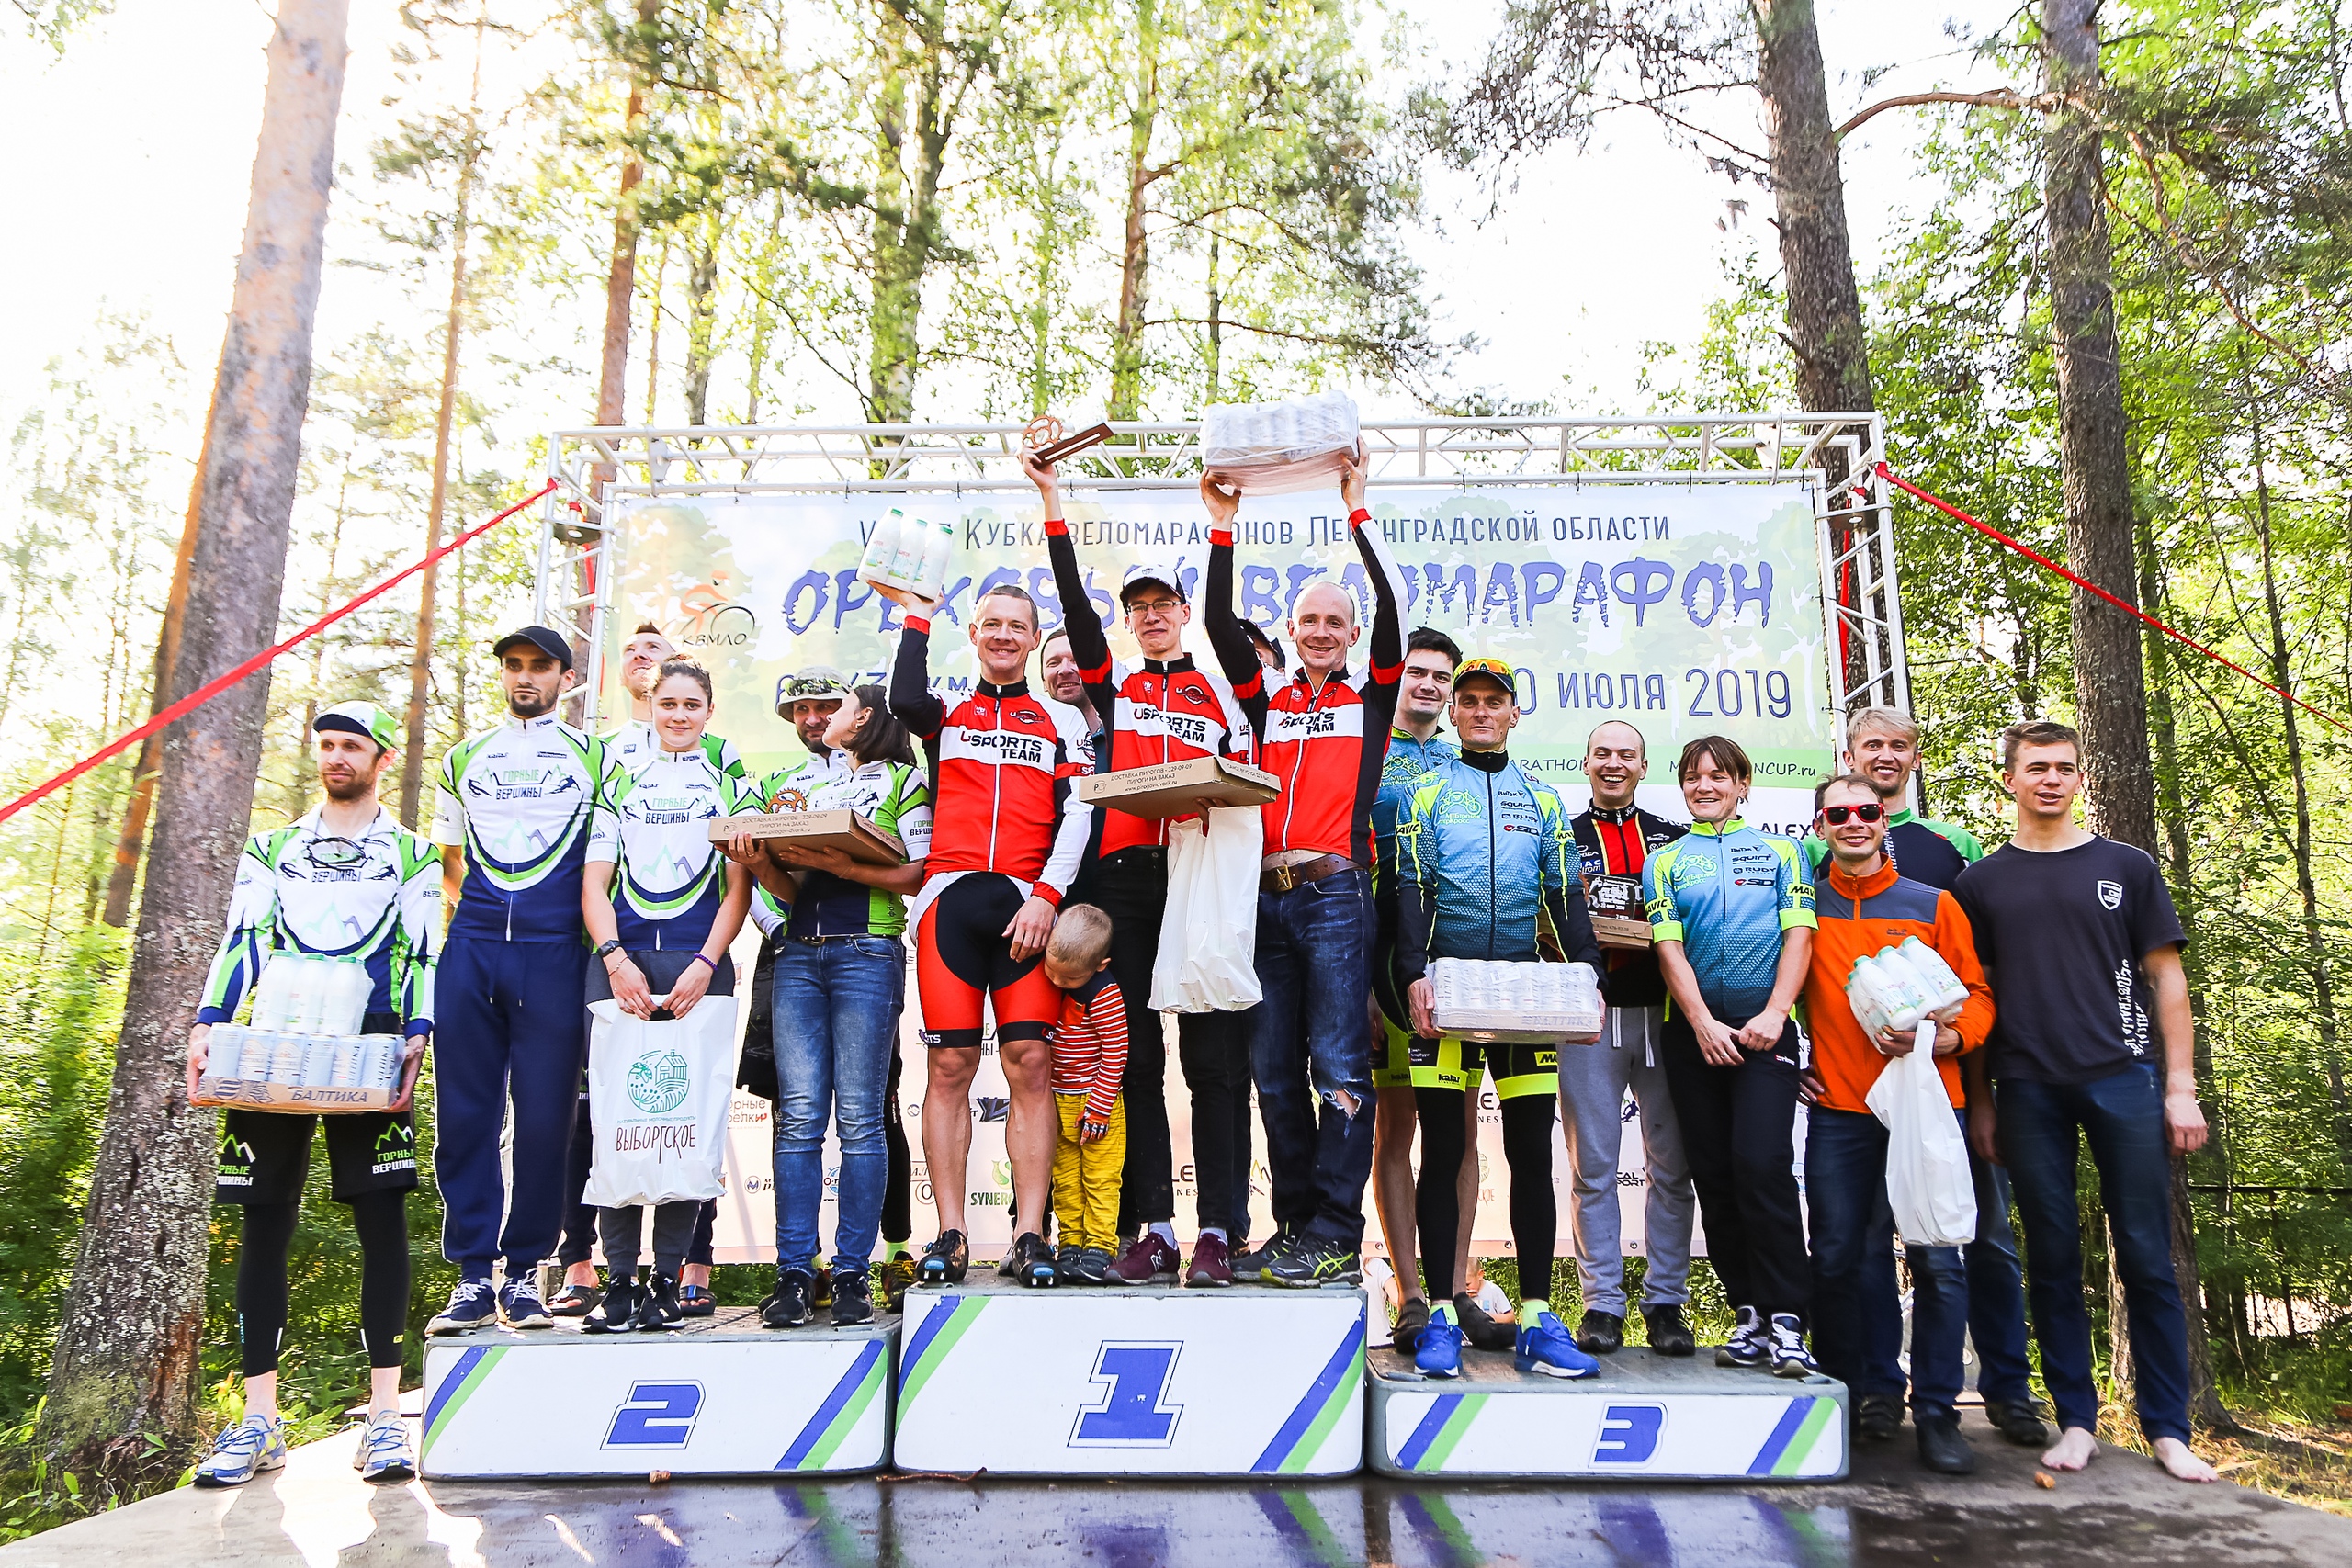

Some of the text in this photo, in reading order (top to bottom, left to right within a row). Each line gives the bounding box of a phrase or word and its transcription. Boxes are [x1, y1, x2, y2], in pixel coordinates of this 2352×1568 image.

[1071, 521, 1293, 545] ВЕЛОМАРАОНОВ
[1307, 510, 1539, 547] ЛЕНГРАДСКОЙ
[1553, 516, 1669, 541] ОБЛАСТИ
[1241, 557, 1773, 628] ВЛМАРАФОН
[1685, 669, 1791, 718] 2019
[1001, 748, 1041, 763] TEAM
[496, 787, 542, 799] ВЕРШИНЫ
[652, 797, 688, 808] ГОРНЫЕ
[645, 813, 689, 824] ВЕРШИНЫ
[311, 870, 361, 882] ВЕРШИНЫ
[1646, 899, 1668, 915] AVIC
[291, 1089, 368, 1102] БАЛТИКА
[616, 1123, 696, 1164] ВЫБОРГСКОЕ
[219, 1165, 250, 1175] РНЫЕ
[372, 1159, 416, 1175] ВЕРШИН
[216, 1176, 253, 1186] ШИНЫ
